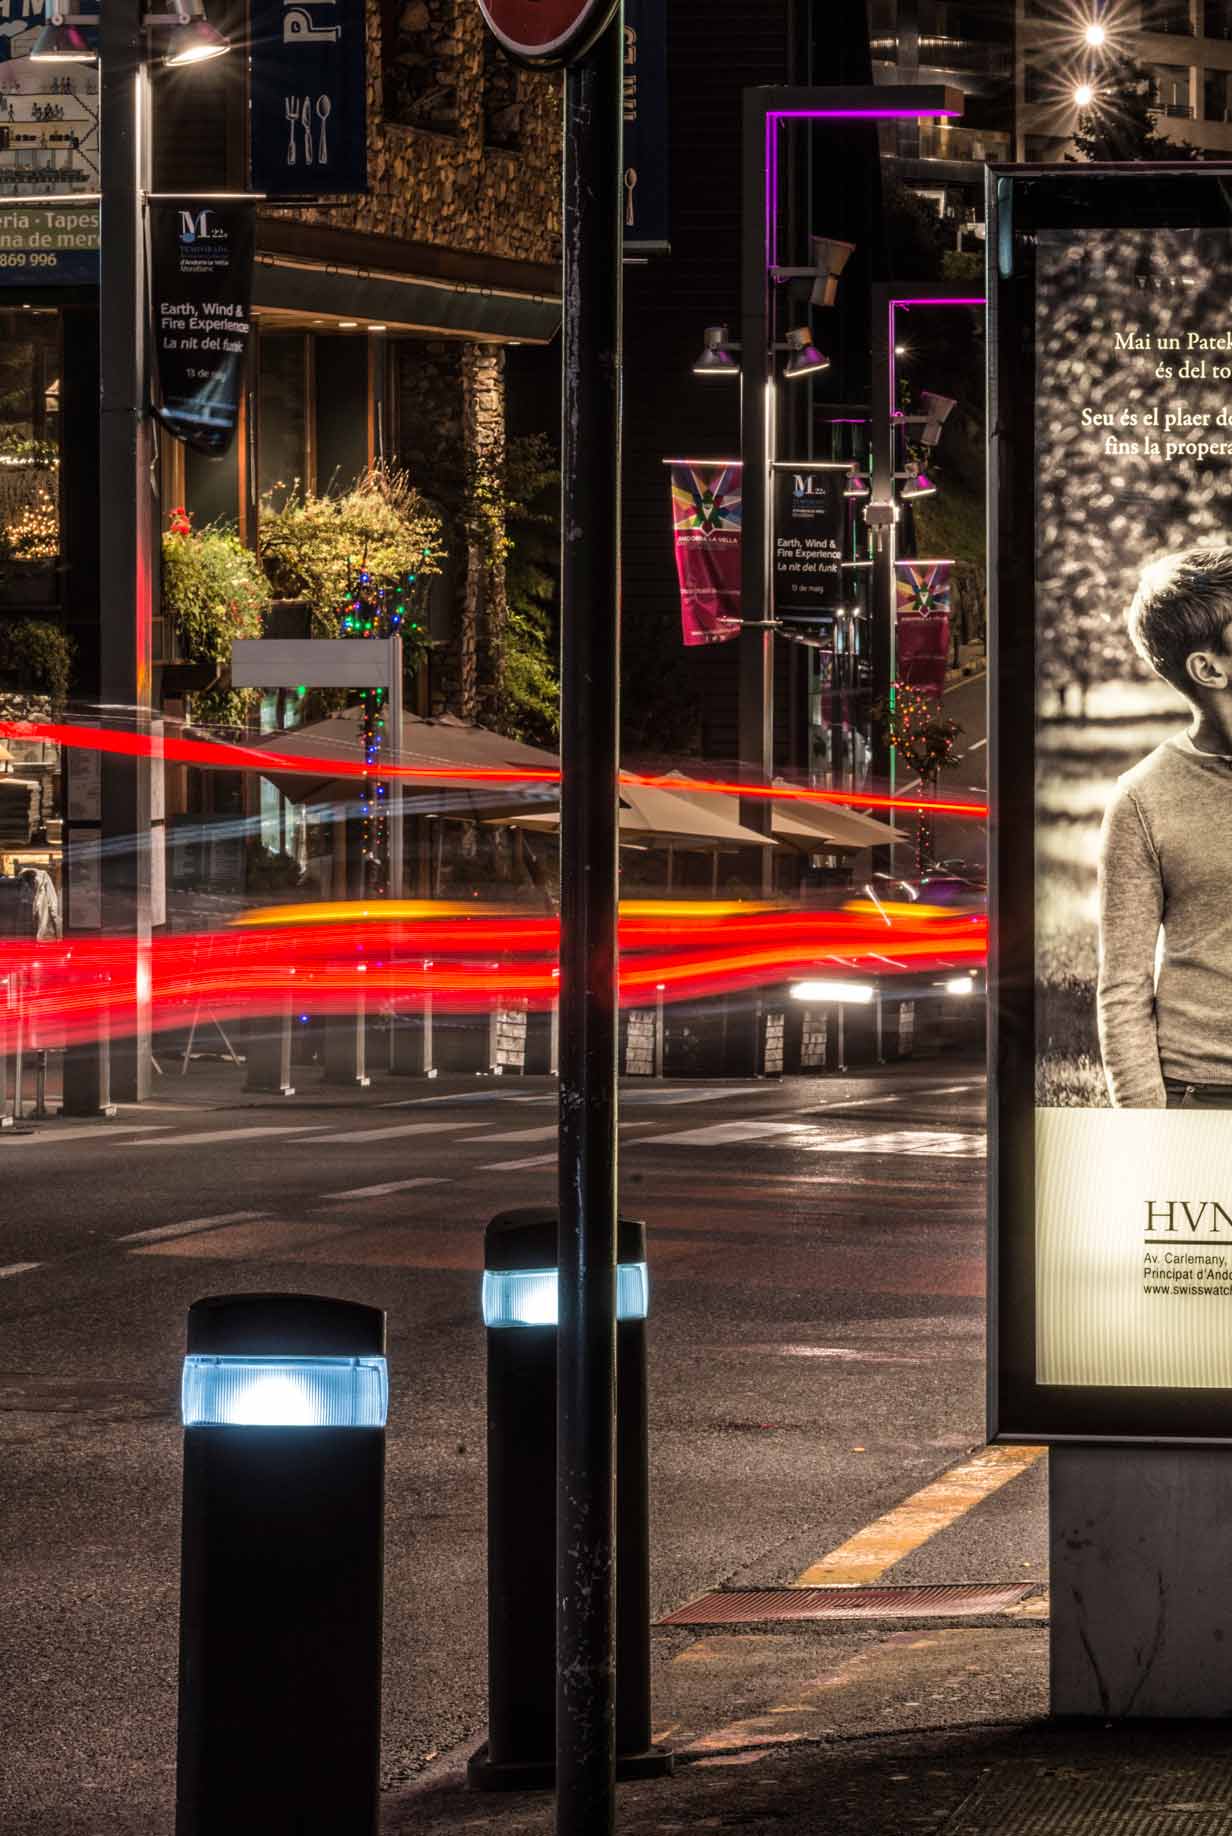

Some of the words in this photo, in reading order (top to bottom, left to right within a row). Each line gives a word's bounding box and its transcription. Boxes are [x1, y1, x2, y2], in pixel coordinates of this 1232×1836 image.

[44, 212, 98, 231] Tapes
[29, 232, 52, 247] de
[31, 253, 57, 267] 996
[160, 303, 198, 317] Earth,
[203, 303, 234, 316] Wind
[161, 318, 186, 330] Fire
[163, 337, 177, 349] La
[181, 338, 198, 350] nit
[201, 338, 220, 351] del
[1115, 332, 1151, 350] Mai
[1157, 336, 1180, 350] un
[1155, 362, 1173, 379] és
[1179, 360, 1206, 379] del
[1081, 407, 1114, 426] Seu
[1120, 407, 1137, 426] és
[1143, 407, 1159, 426] el
[1164, 407, 1210, 432] plaer
[1105, 436, 1138, 455] fins
[1144, 436, 1161, 455] la
[805, 539, 827, 549] Wind
[777, 549, 793, 558] Fire
[795, 550, 841, 561] Experience
[777, 562, 787, 572] La
[789, 563, 800, 572] nit
[802, 563, 816, 573] del
[1164, 1252, 1228, 1268] Carlemany,
[1144, 1267, 1193, 1282] Principat
